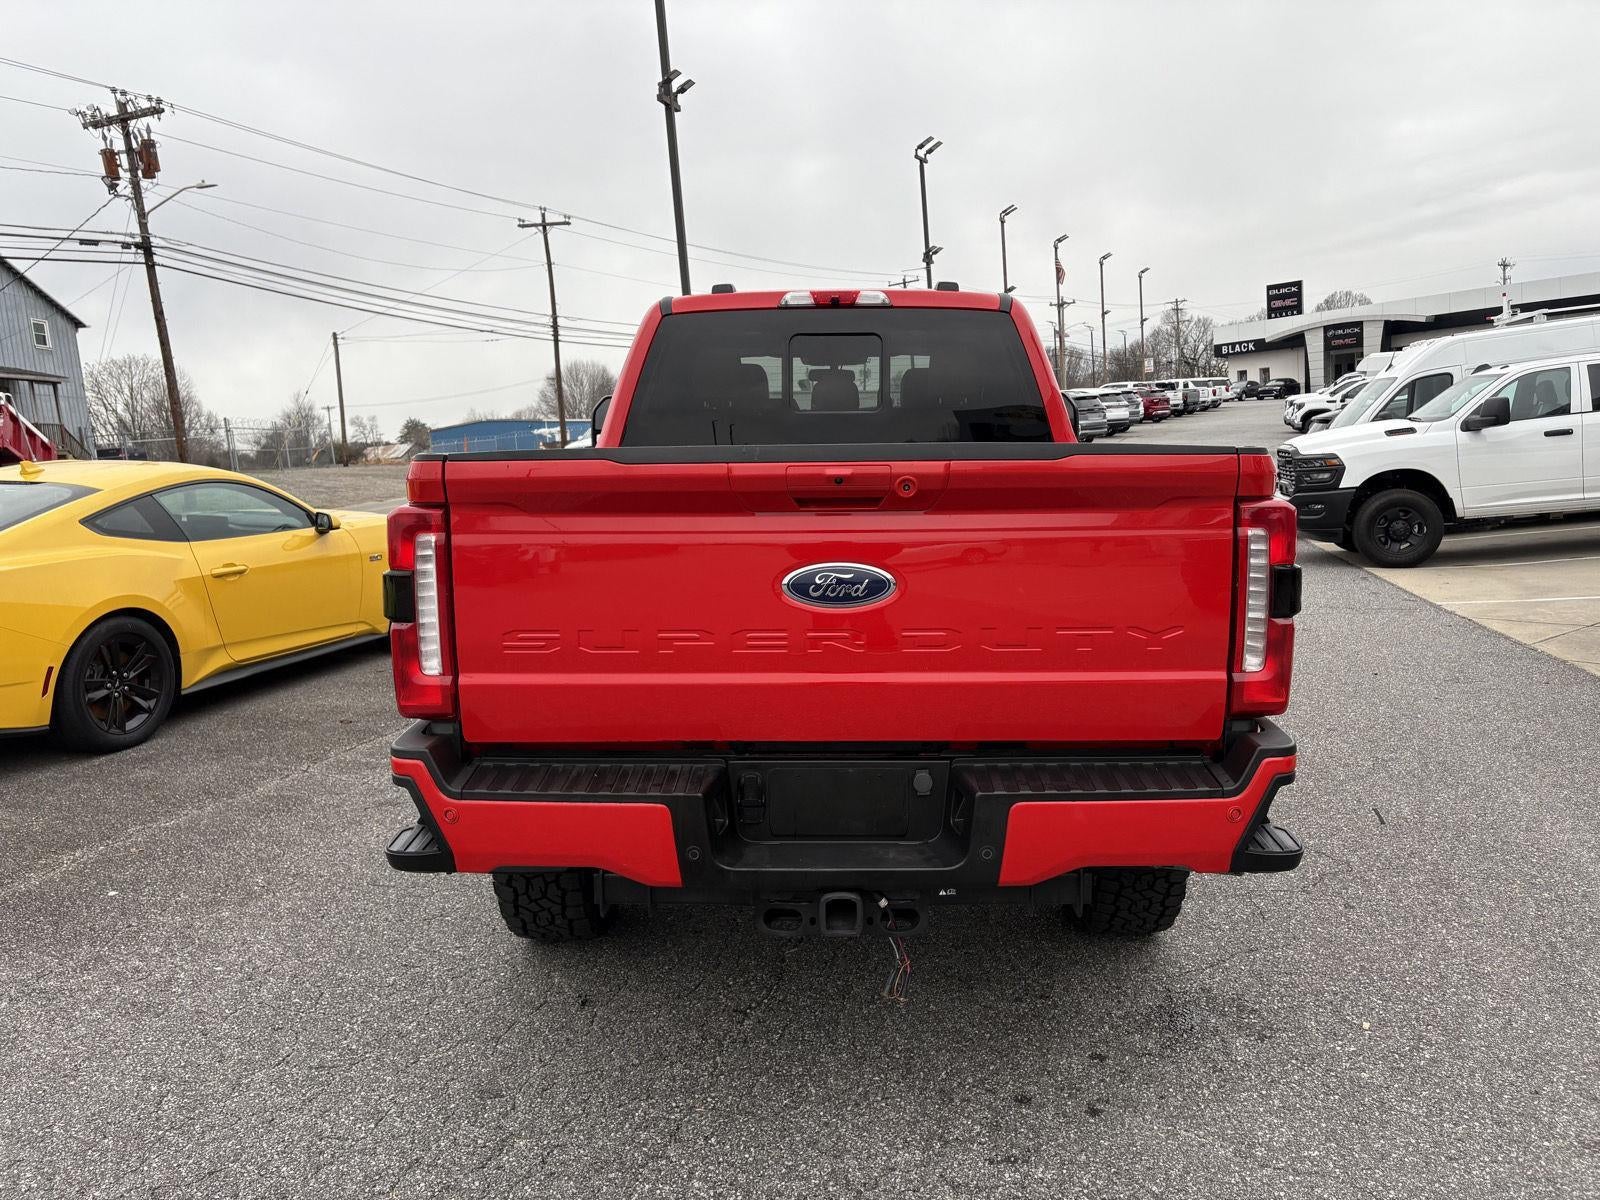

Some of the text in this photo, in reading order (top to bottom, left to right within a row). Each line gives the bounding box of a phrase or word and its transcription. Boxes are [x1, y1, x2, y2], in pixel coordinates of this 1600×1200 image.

[1269, 286, 1299, 295] BUICK
[1270, 297, 1298, 308] GMC
[1271, 310, 1298, 318] BLACK
[1334, 326, 1361, 336] BUICK
[1331, 337, 1357, 346] GMC
[1221, 342, 1256, 355] BLACK
[808, 572, 869, 598] Ford
[502, 626, 1185, 653] SUPER DUTY
